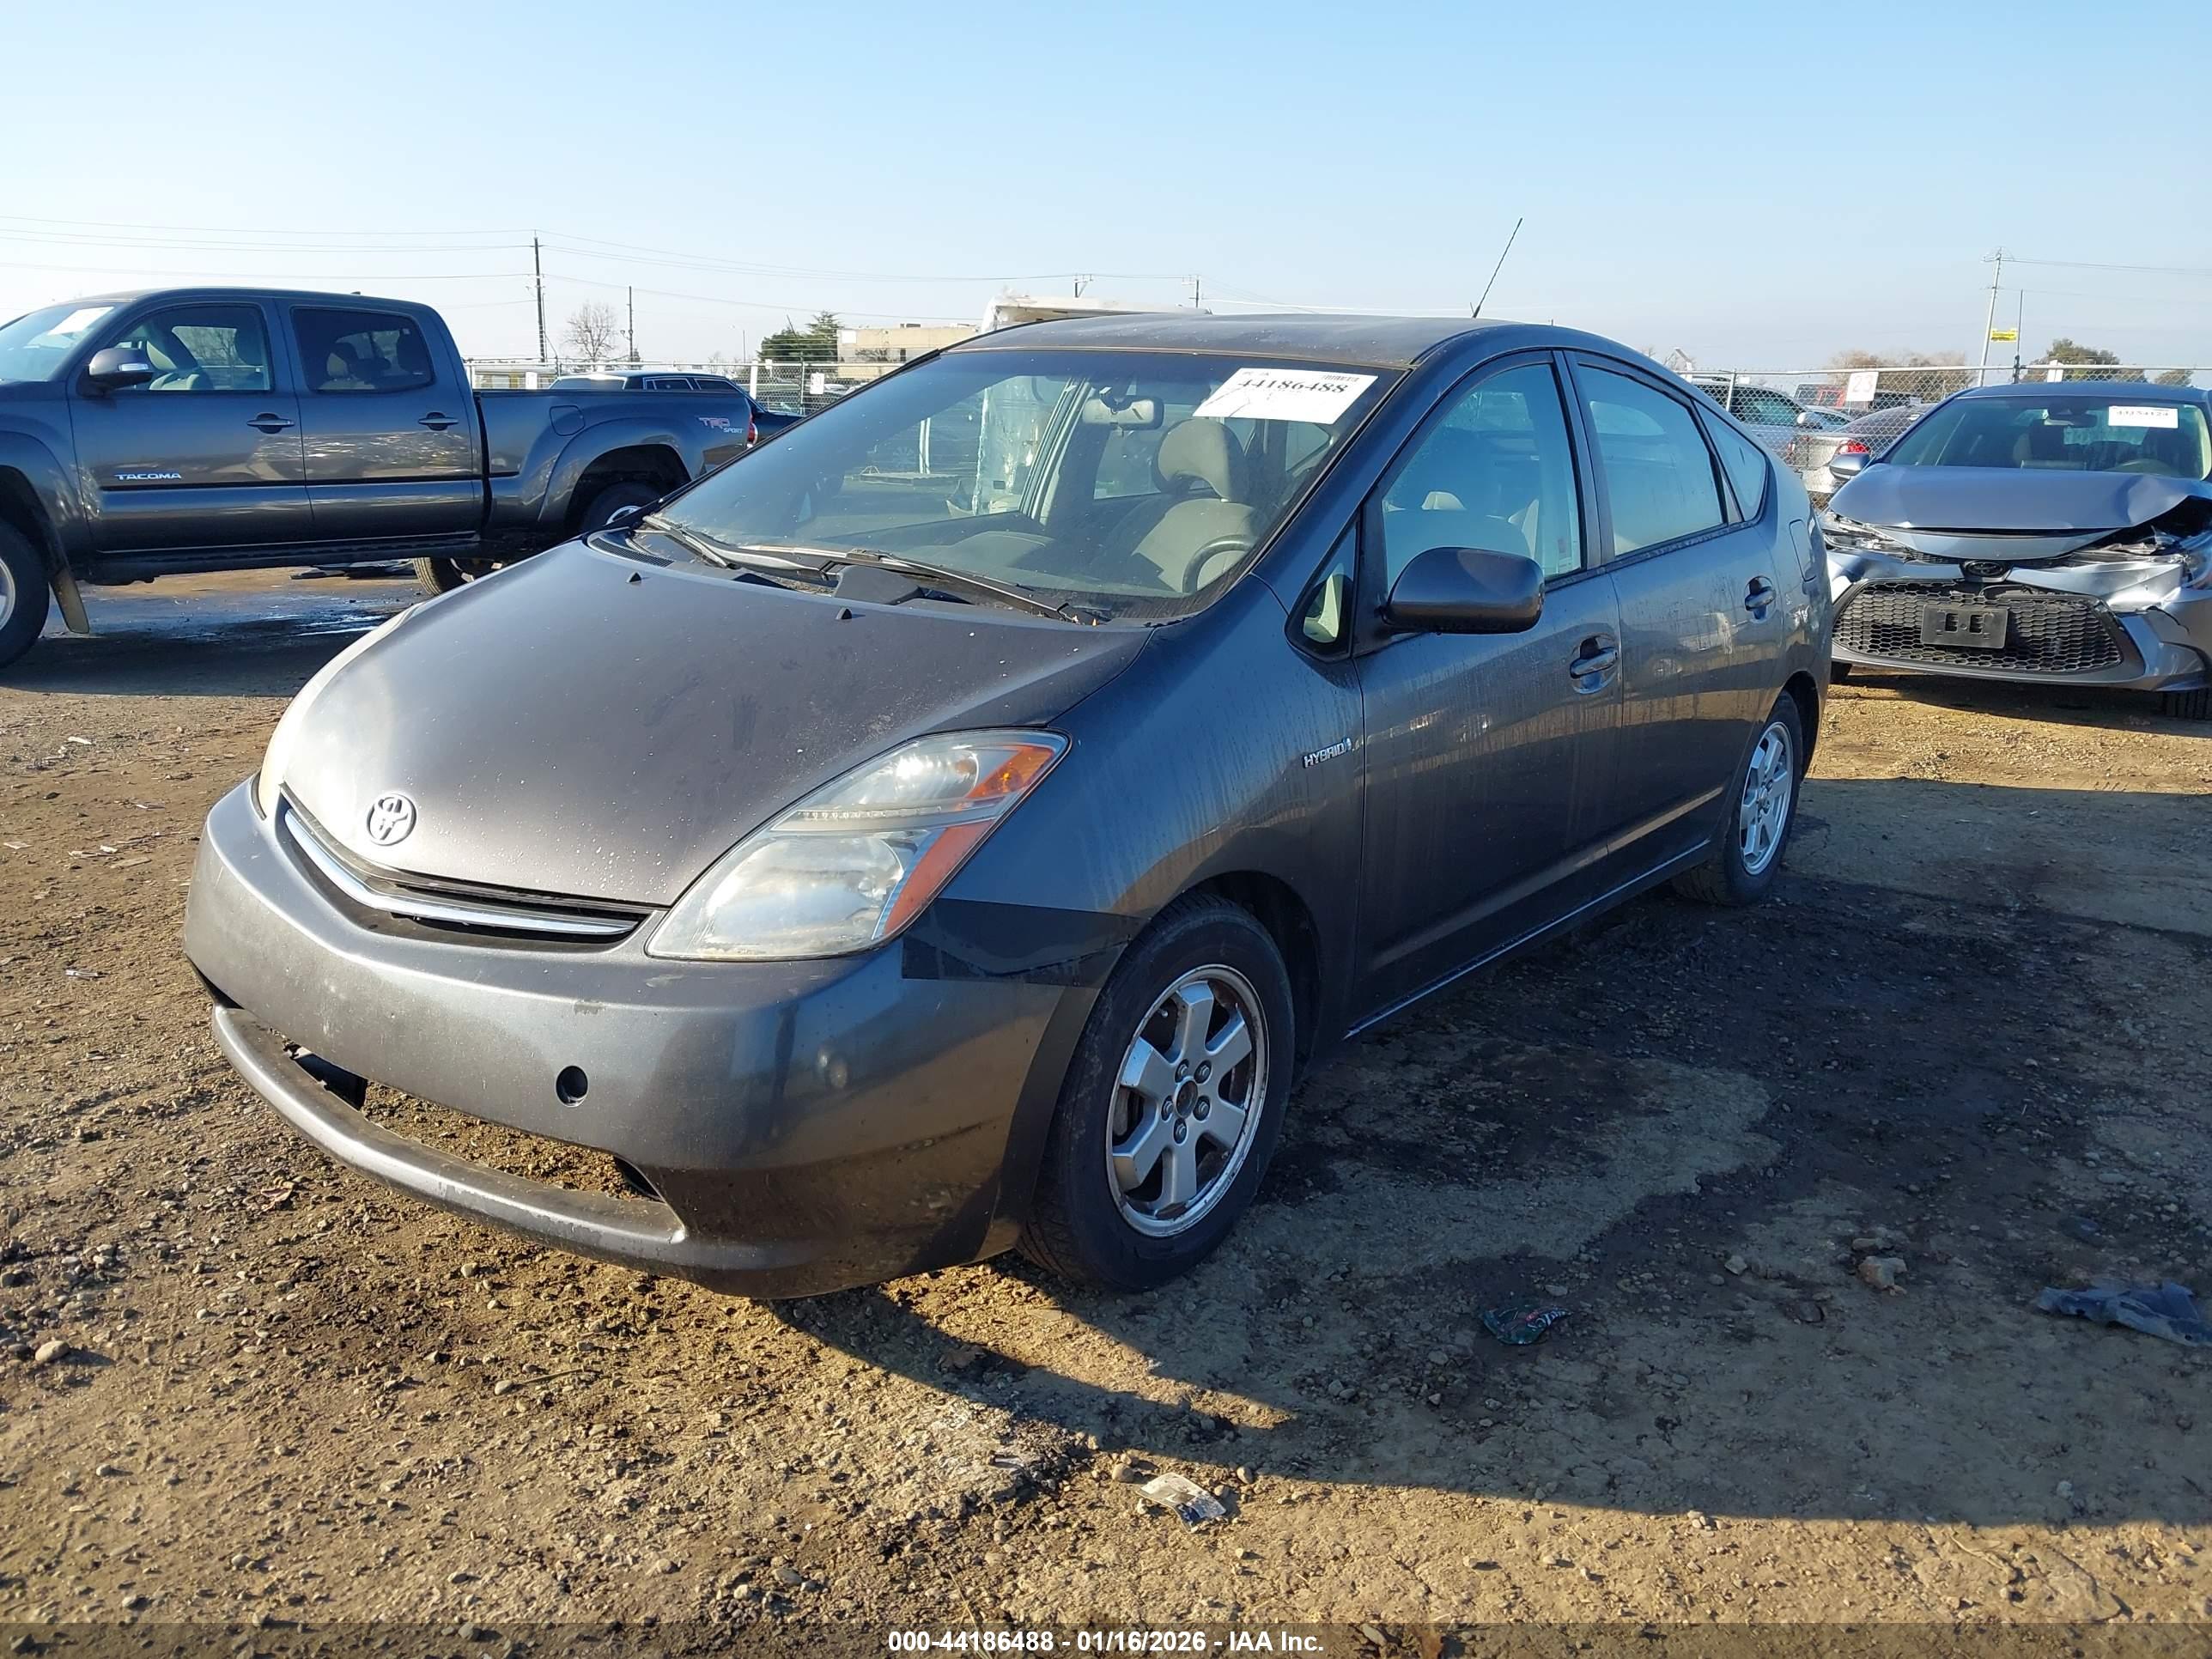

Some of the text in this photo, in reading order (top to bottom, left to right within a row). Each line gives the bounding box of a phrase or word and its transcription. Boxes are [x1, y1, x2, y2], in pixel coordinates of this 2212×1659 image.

[1237, 379, 1349, 393] 44186488
[697, 416, 731, 428] TRD
[114, 472, 182, 481] TACOMA
[1303, 742, 1346, 769] HYBRID
